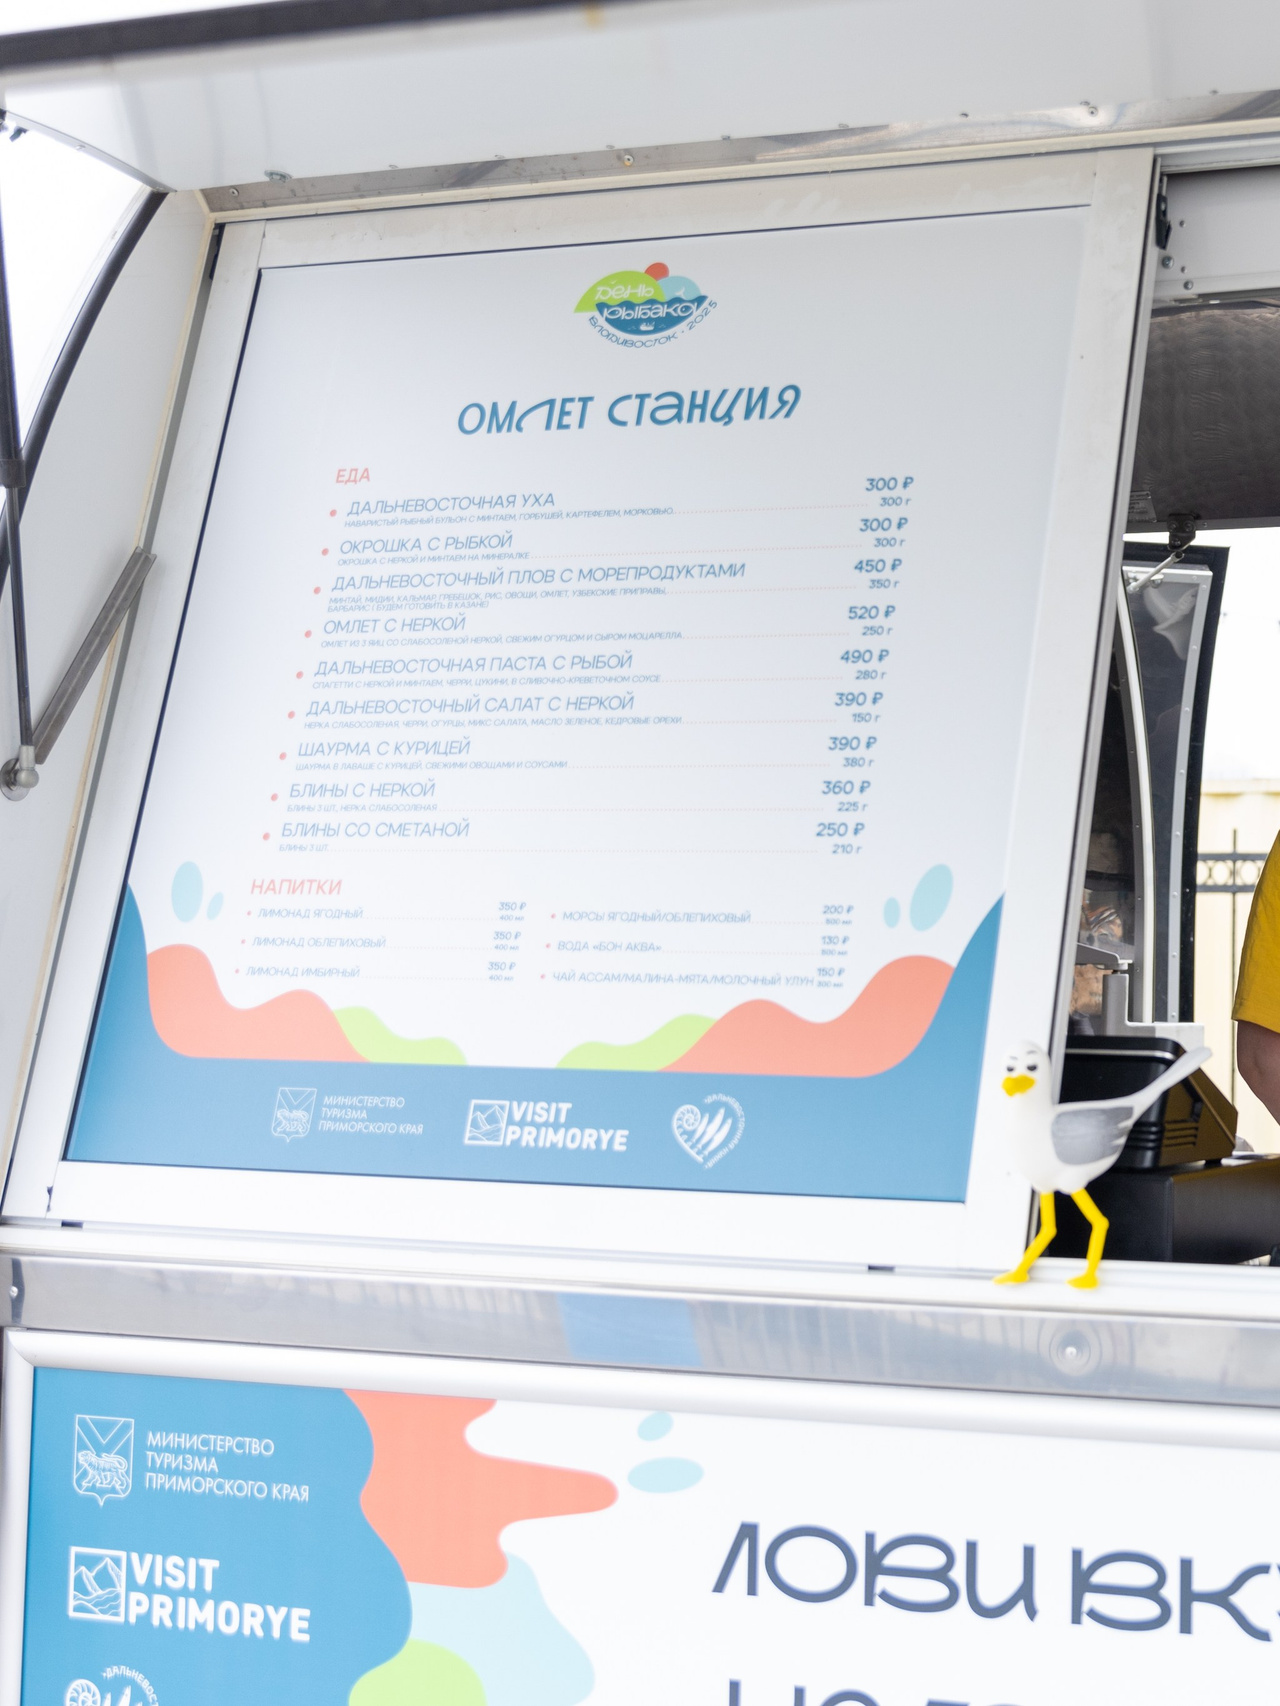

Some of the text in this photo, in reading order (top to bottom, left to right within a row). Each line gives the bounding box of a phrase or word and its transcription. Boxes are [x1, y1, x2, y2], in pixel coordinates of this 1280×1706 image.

[687, 300, 718, 331] 2025
[458, 396, 595, 435] ОМЛЕТ
[336, 468, 370, 485] ЕДА
[865, 477, 898, 492] 300
[347, 493, 555, 517] ДАЛЬНЕВОСТОЧНАЯ УХА
[880, 496, 903, 507] 300
[859, 517, 892, 532] 300
[340, 530, 513, 554] ОКРОШКА С РЫБКОЙ
[874, 537, 897, 548] 300
[854, 559, 886, 573] 450
[331, 563, 746, 592] ДАЛЬНЕВОСТОЧНЫЙ ПЛОВ С МОРЕПРОДУКТАМИ
[869, 578, 891, 589] 350
[848, 605, 879, 620] 520
[323, 612, 466, 634] ОМЛЕТ С НЕРКОЙ
[862, 625, 884, 636] 250
[314, 650, 633, 677] ДАЛЬНЕВОСТОЧНАЯ ПАСТА С РЫБОЙ
[840, 649, 873, 664] 490
[855, 669, 878, 680] 280
[305, 691, 635, 717] ДАЛЬНЕВОСТОЧНЫЙ САЛАТ С НЕРКОЙ
[835, 692, 867, 707] 390
[852, 712, 872, 723] 150
[298, 736, 471, 757] ШАУРМА С КУРИЦЕЙ
[828, 736, 861, 751] 390
[843, 757, 866, 768] 380
[289, 778, 436, 798] БЛИНЫ С НЕРКОЙ
[822, 780, 854, 795] 360
[837, 802, 859, 812] 225
[281, 818, 470, 837] БЛИНЫ СО СМЕТАНОЙ
[816, 822, 848, 837] 250
[832, 844, 853, 854] 210
[250, 879, 342, 895] НАПИТКИ
[323, 1096, 405, 1109] МИНИСТЕРСТВО
[321, 1107, 368, 1119] ТУРИЗМА
[512, 1100, 573, 1124] VISIT
[319, 1120, 424, 1135] ПРИМОРСКОГО КРАЯ
[505, 1125, 629, 1152] PRIMORYE
[148, 1431, 275, 1455] МИНИСТЕРСТВО
[147, 1452, 219, 1473] ТУРИЗМА
[146, 1473, 310, 1502] ПРИМОРСКОГО КРАЯ
[130, 1552, 220, 1592] VISIT
[711, 1521, 1038, 1622] ЛОВИ
[128, 1592, 311, 1643] PRIMORYE
